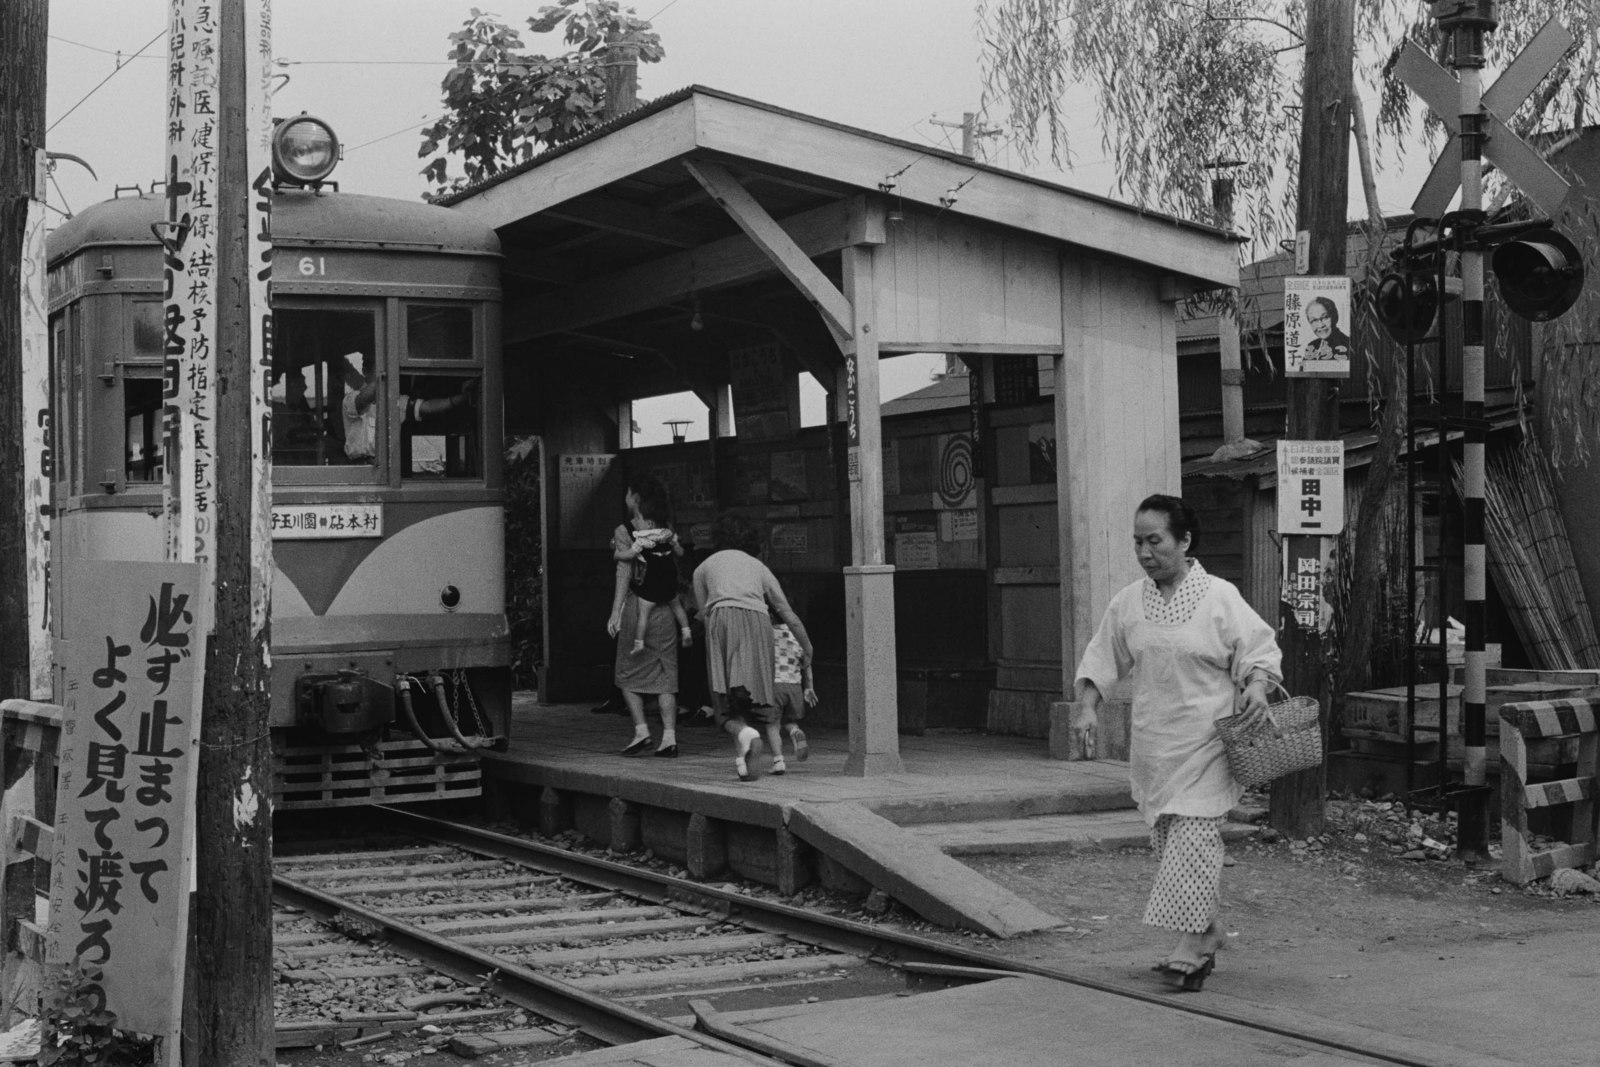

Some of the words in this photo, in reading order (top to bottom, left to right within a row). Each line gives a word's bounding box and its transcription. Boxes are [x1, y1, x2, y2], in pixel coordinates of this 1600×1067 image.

[299, 256, 325, 276] 61
[1286, 293, 1302, 367] 藤原道子
[846, 357, 857, 440] なかこうち
[328, 513, 380, 531] 砧本村
[1301, 479, 1321, 528] 田中一
[1297, 557, 1316, 627] 岡田宗司
[129, 582, 193, 904] 必ず止まって
[74, 635, 132, 1013] よく見て渡ろう
